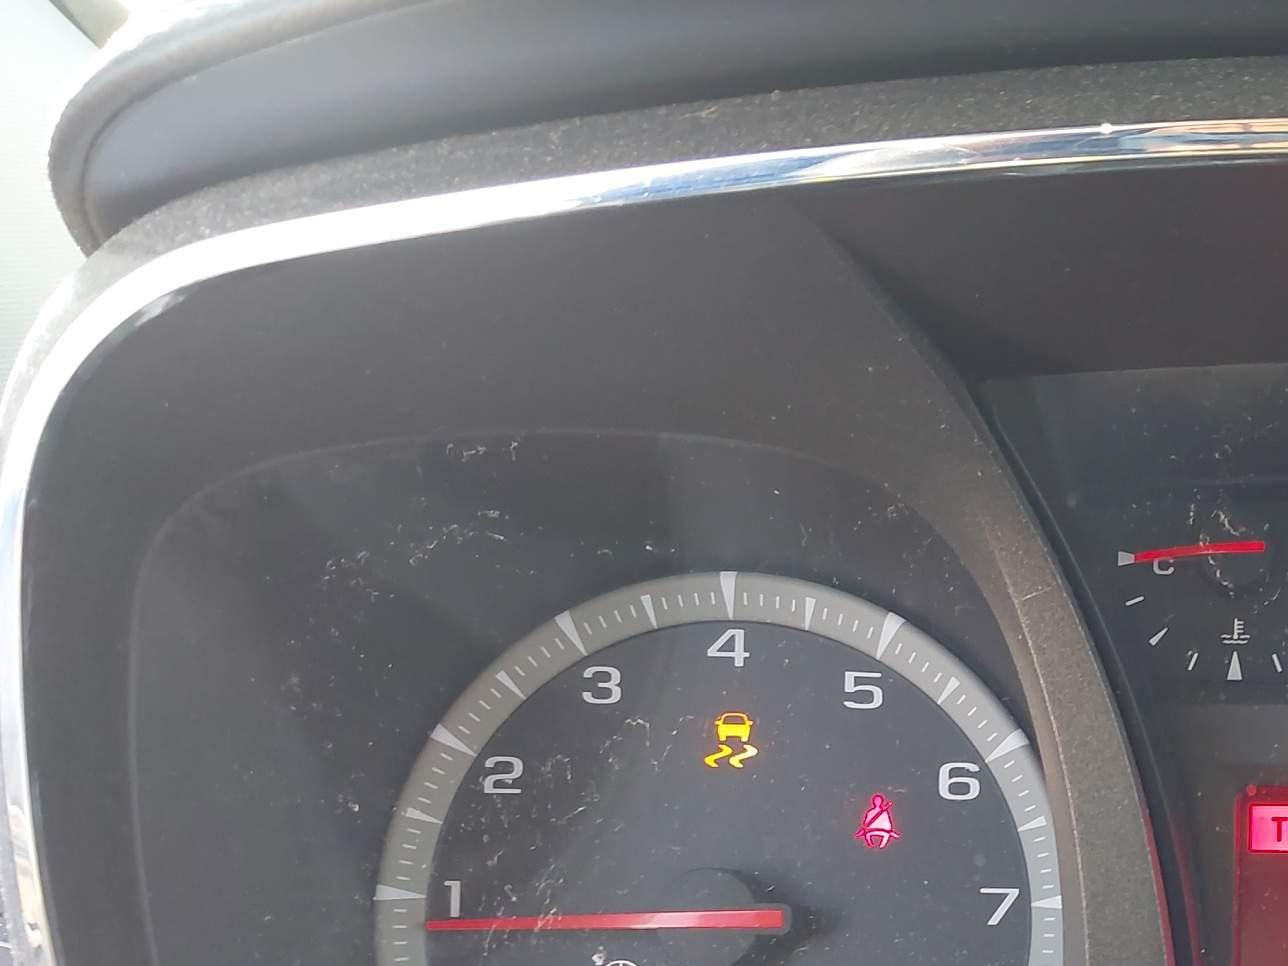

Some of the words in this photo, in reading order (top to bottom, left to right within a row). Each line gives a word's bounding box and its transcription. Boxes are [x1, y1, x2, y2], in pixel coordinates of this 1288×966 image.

[1152, 557, 1174, 576] C
[706, 630, 750, 666] 4
[582, 667, 622, 704] 3
[843, 671, 883, 709] 5
[483, 756, 522, 794] 2
[938, 762, 981, 800] 6
[444, 881, 461, 917] 1
[979, 888, 1019, 925] 7
